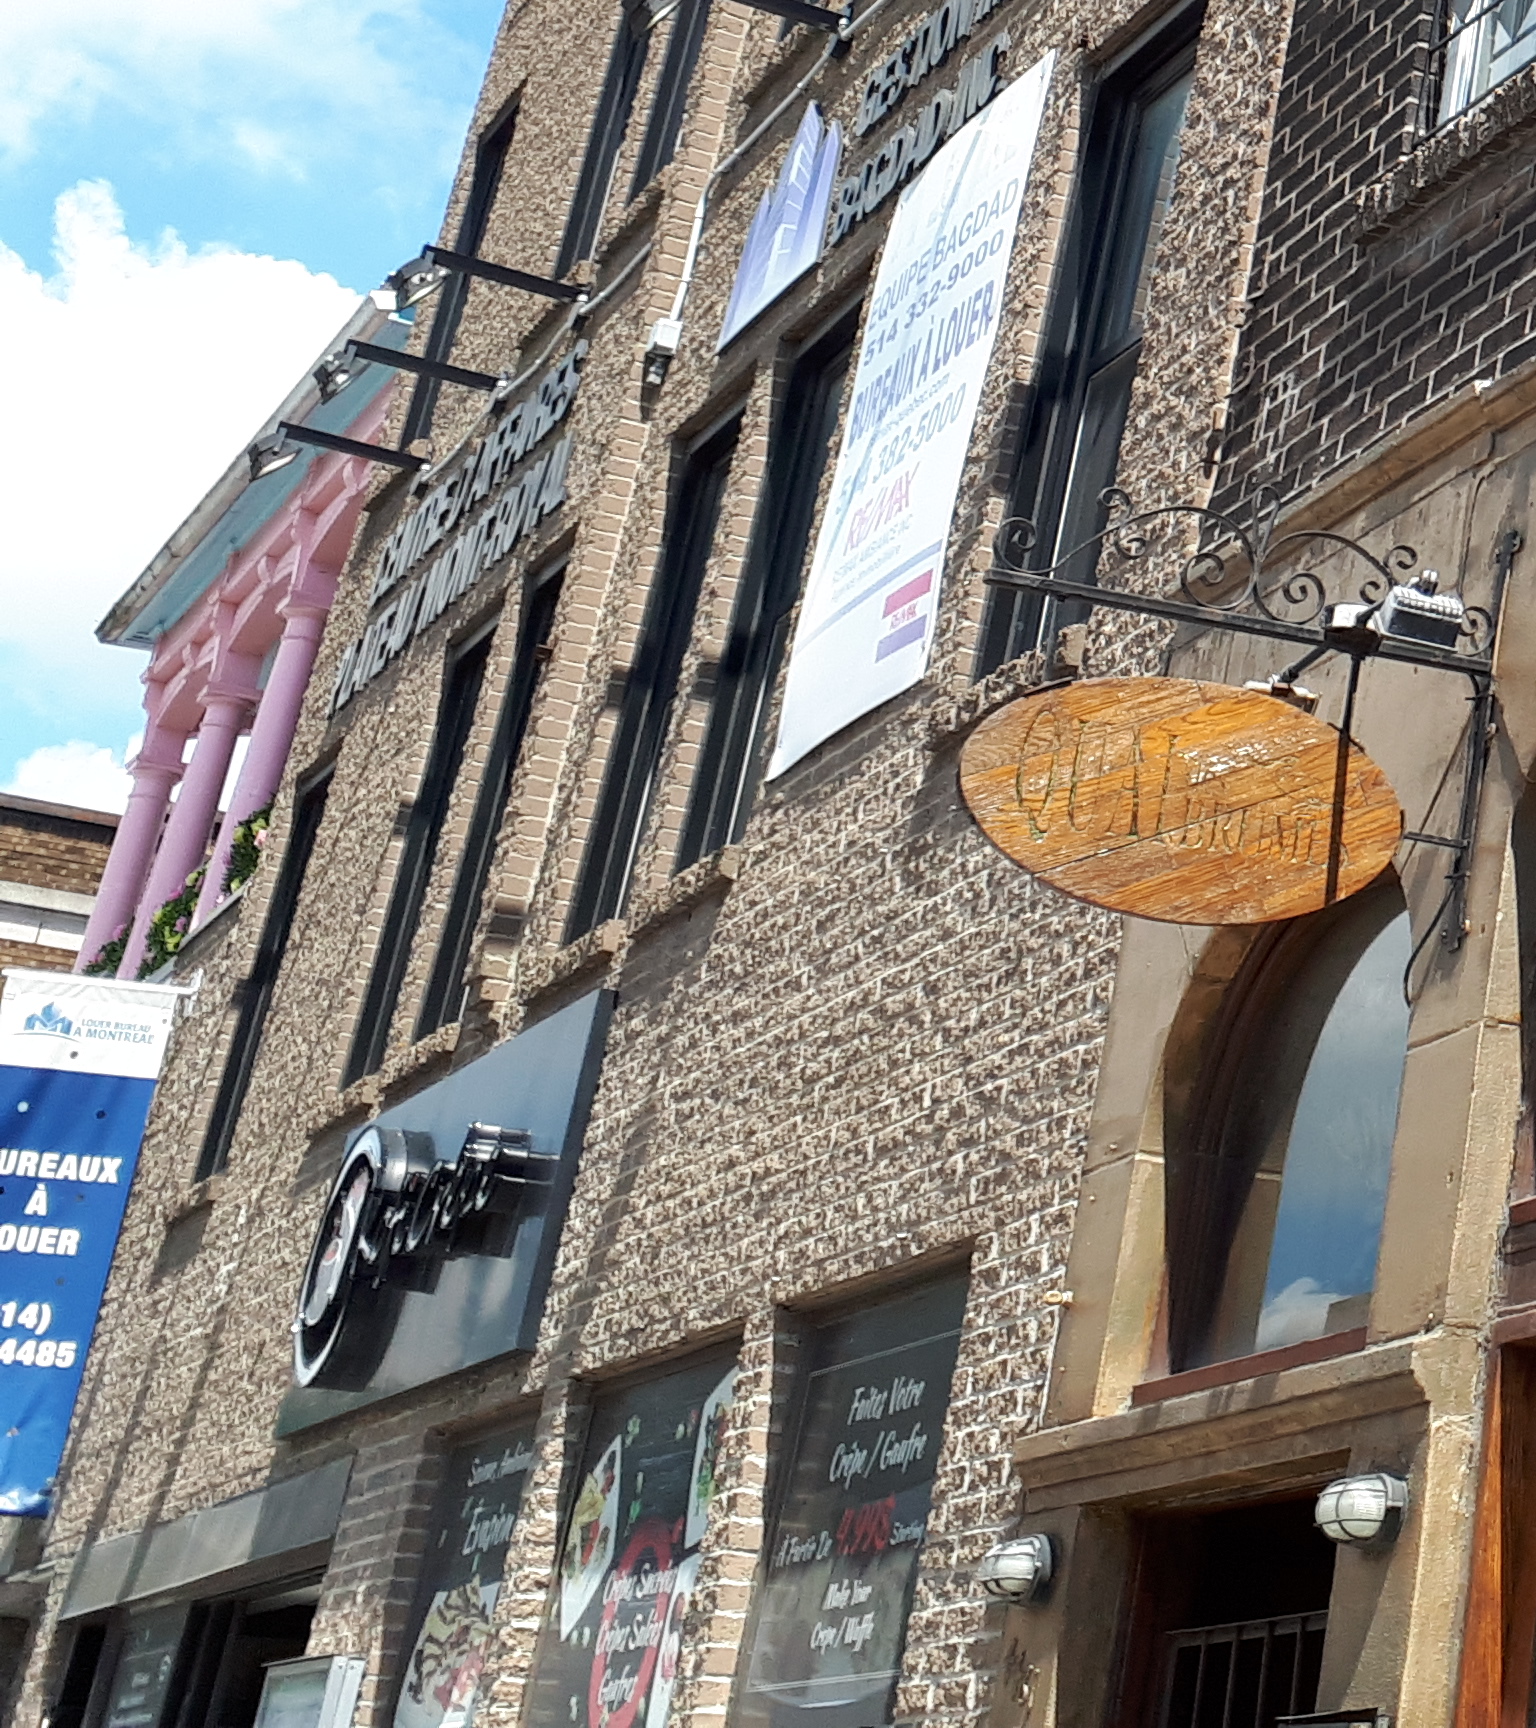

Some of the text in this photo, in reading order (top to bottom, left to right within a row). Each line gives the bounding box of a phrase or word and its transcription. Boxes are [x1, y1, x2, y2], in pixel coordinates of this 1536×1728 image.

[829, 88, 954, 246] BAGDAD
[932, 177, 1019, 271] BAGDAD
[846, 335, 926, 450] BUREAUX
[932, 279, 997, 368] LOUER
[864, 228, 1006, 368] 514 332-9000
[871, 382, 967, 486] 382-5000
[368, 470, 462, 609] CENTRE
[326, 578, 422, 720] PLATEAU
[23, 1182, 49, 1217] À
